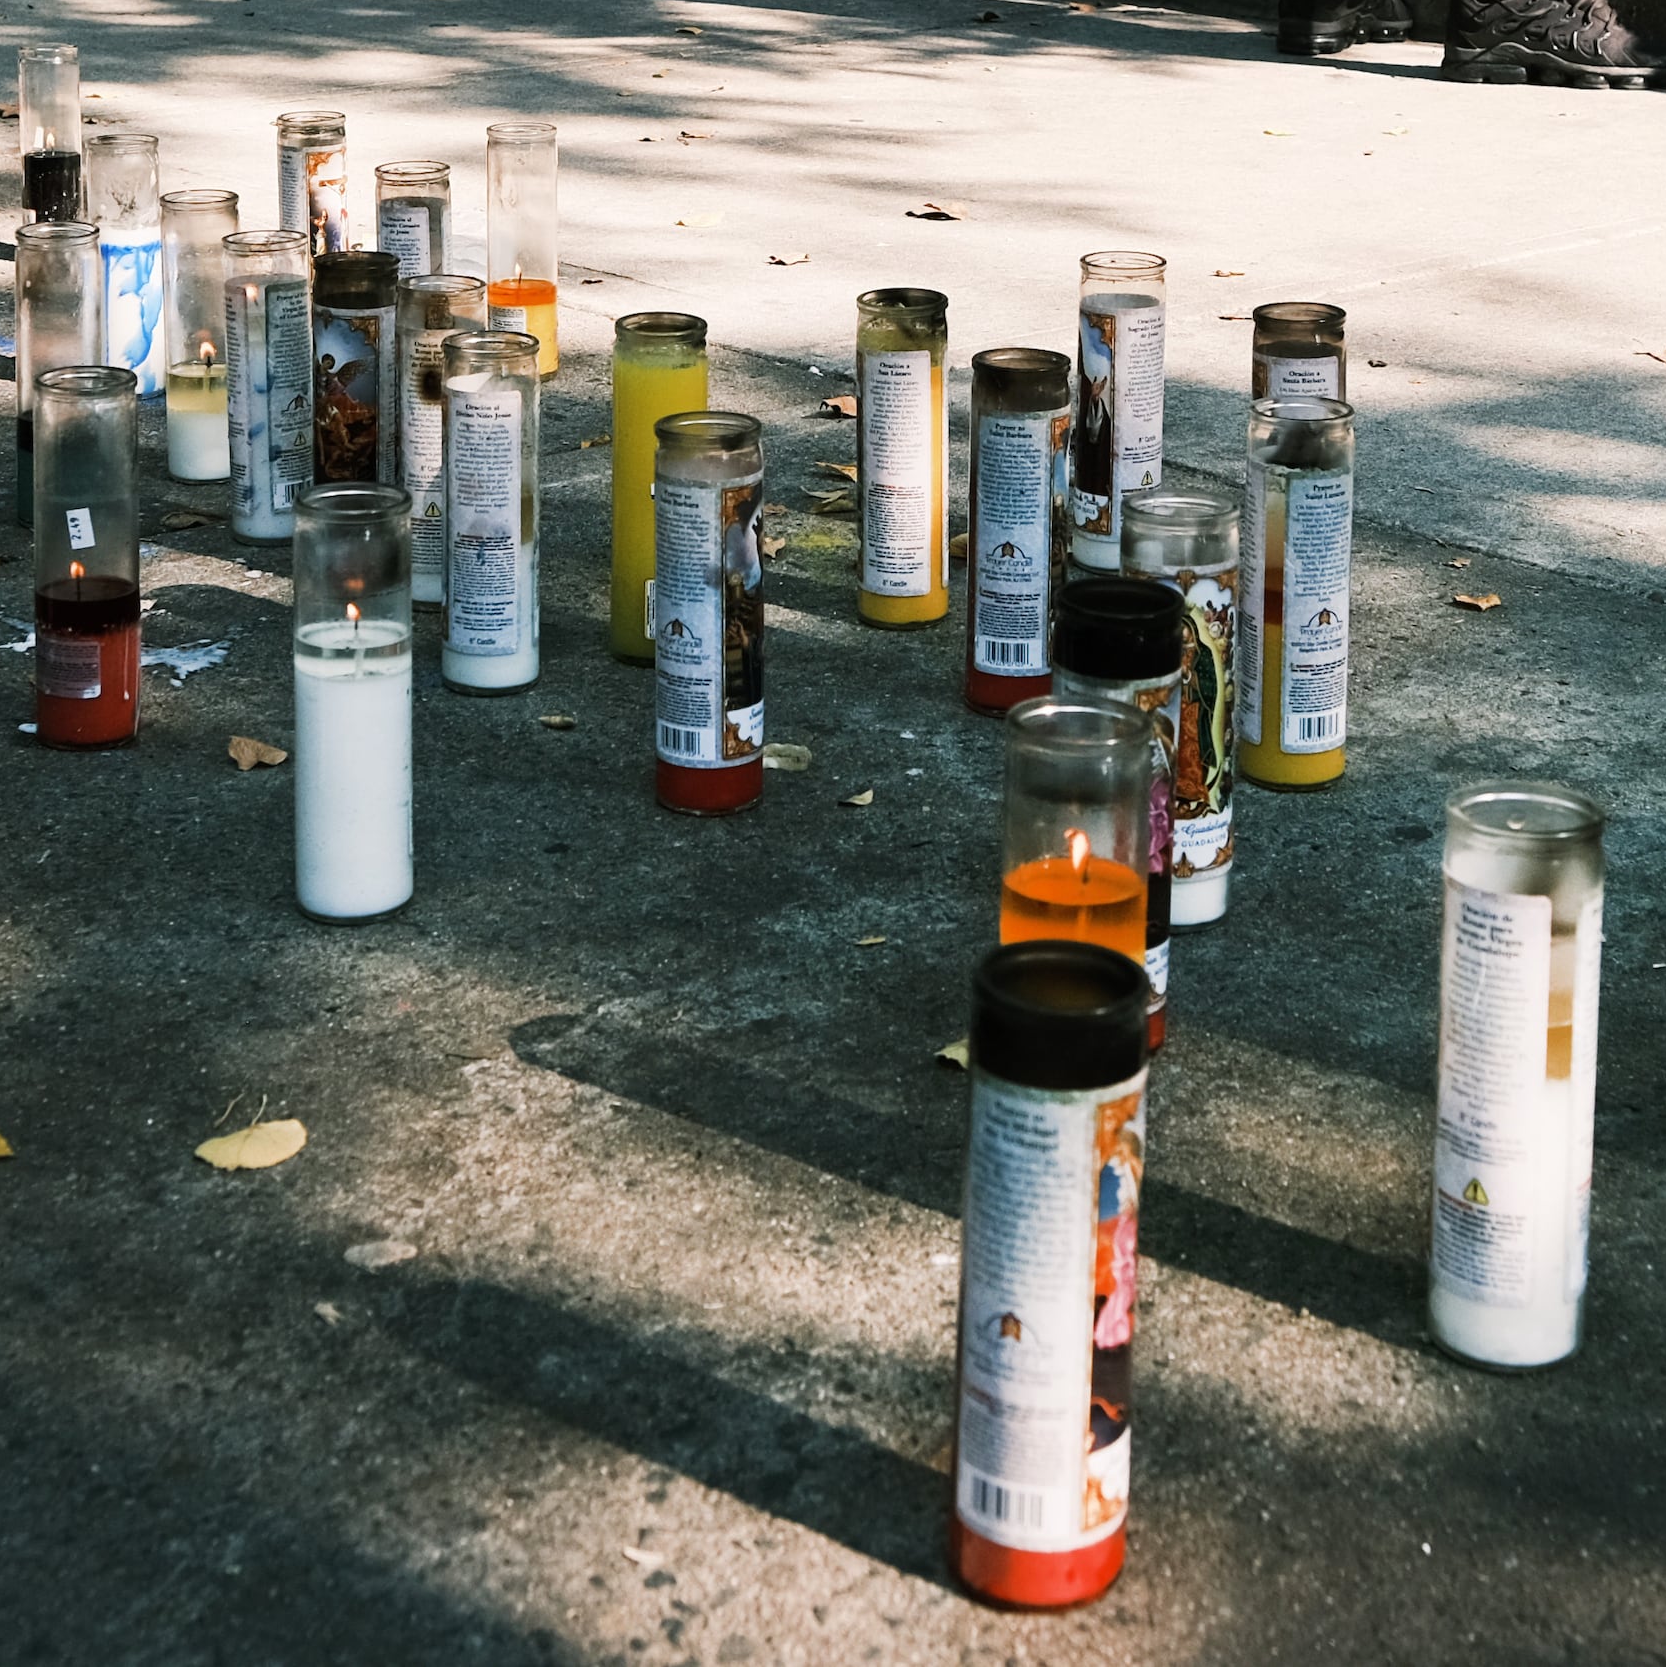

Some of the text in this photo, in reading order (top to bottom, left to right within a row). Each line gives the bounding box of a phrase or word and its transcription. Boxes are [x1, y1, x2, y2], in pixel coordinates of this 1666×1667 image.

[995, 423, 1017, 431] Prayer
[1006, 431, 1033, 439] Barbara
[1313, 484, 1334, 492] Prayer
[673, 499, 699, 509] Barbara
[69, 517, 82, 540] 2.49
[1462, 902, 1513, 922] Oración de
[1490, 925, 1513, 936] para
[1456, 936, 1520, 959] de Guadalupe
[1490, 934, 1524, 947] Virgen
[994, 1100, 1029, 1119] Prayer
[1013, 1122, 1059, 1138] Michael
[983, 1124, 1059, 1153] the Archangel
